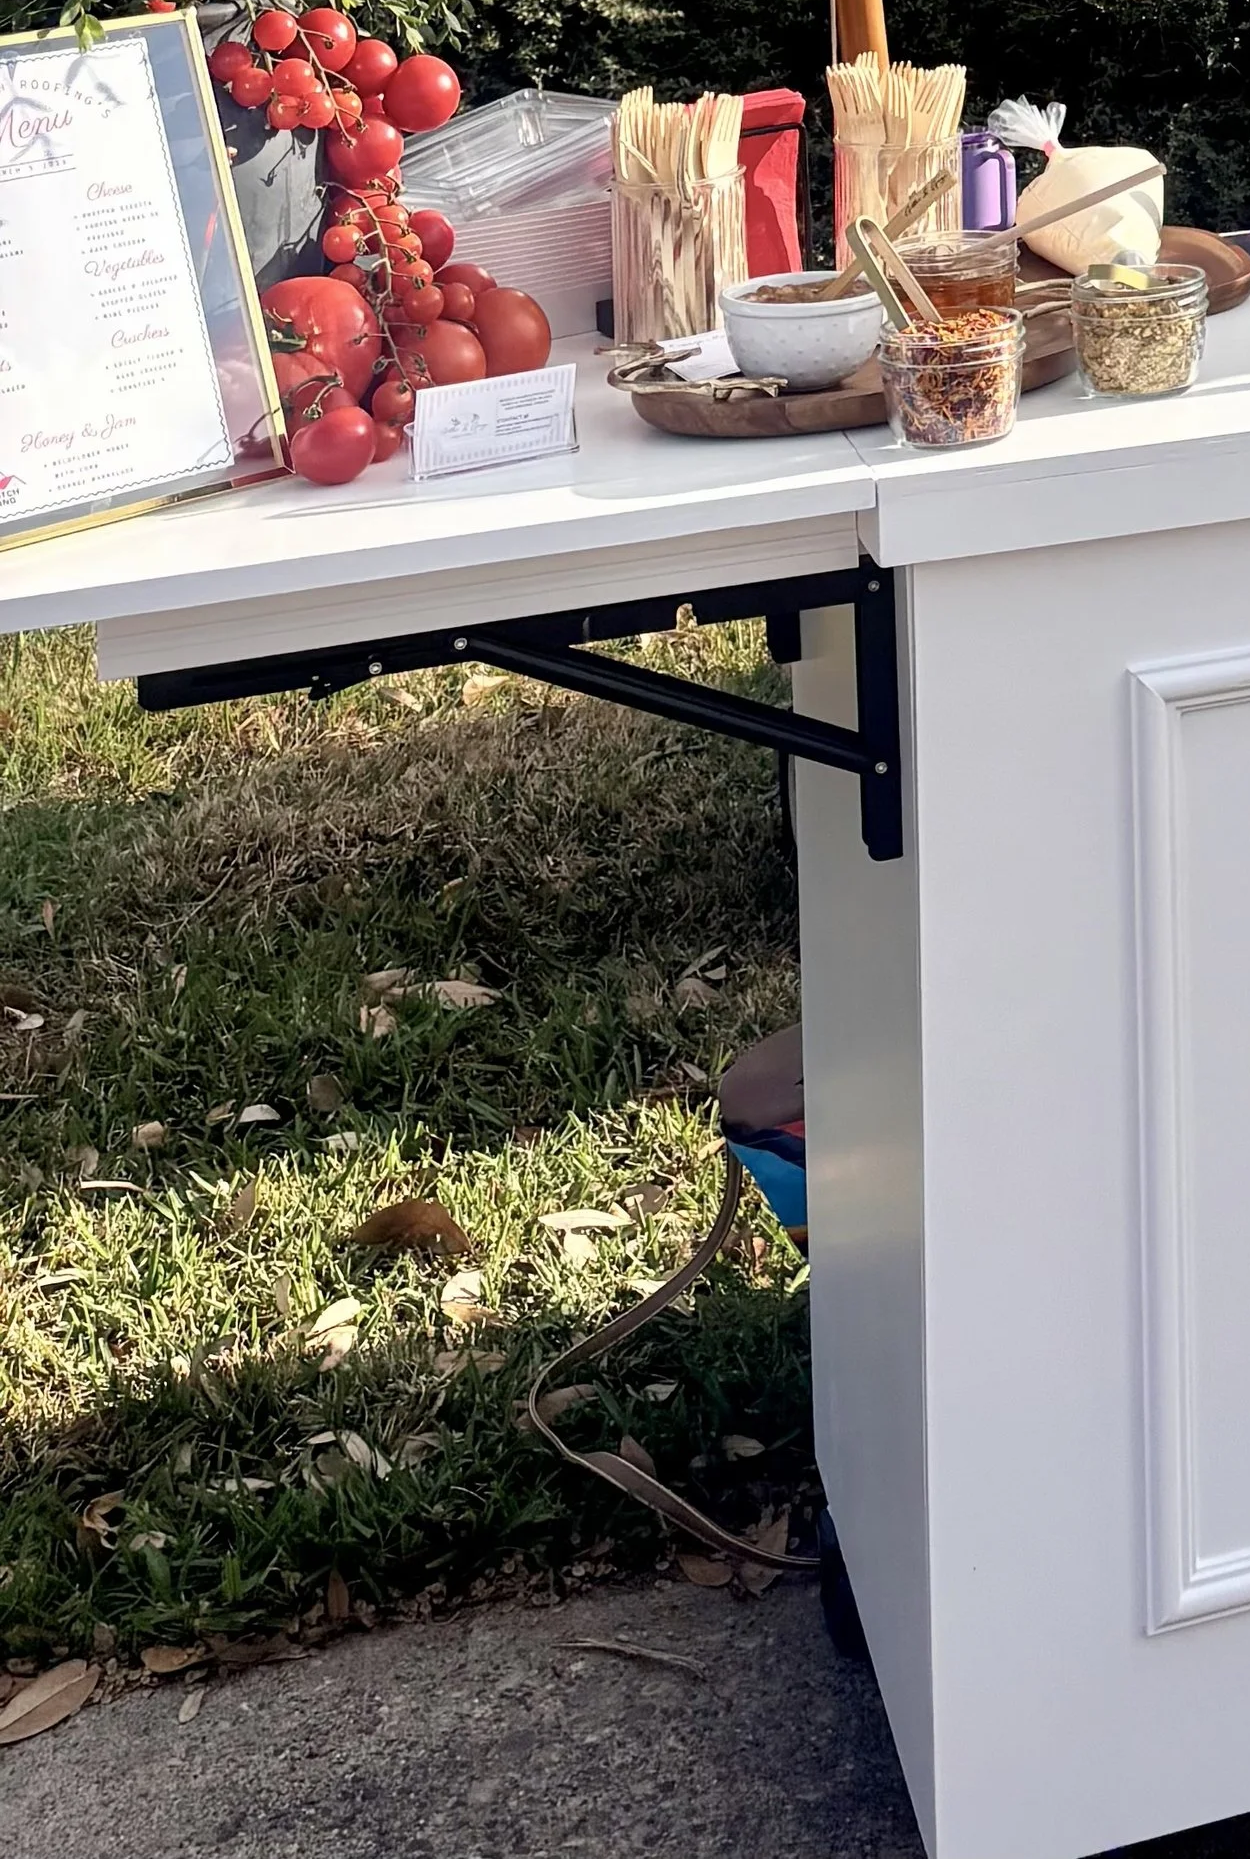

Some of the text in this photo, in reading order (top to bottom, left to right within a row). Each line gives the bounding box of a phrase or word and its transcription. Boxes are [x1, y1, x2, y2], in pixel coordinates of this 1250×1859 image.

[20, 413, 137, 453] Honey & Jam
